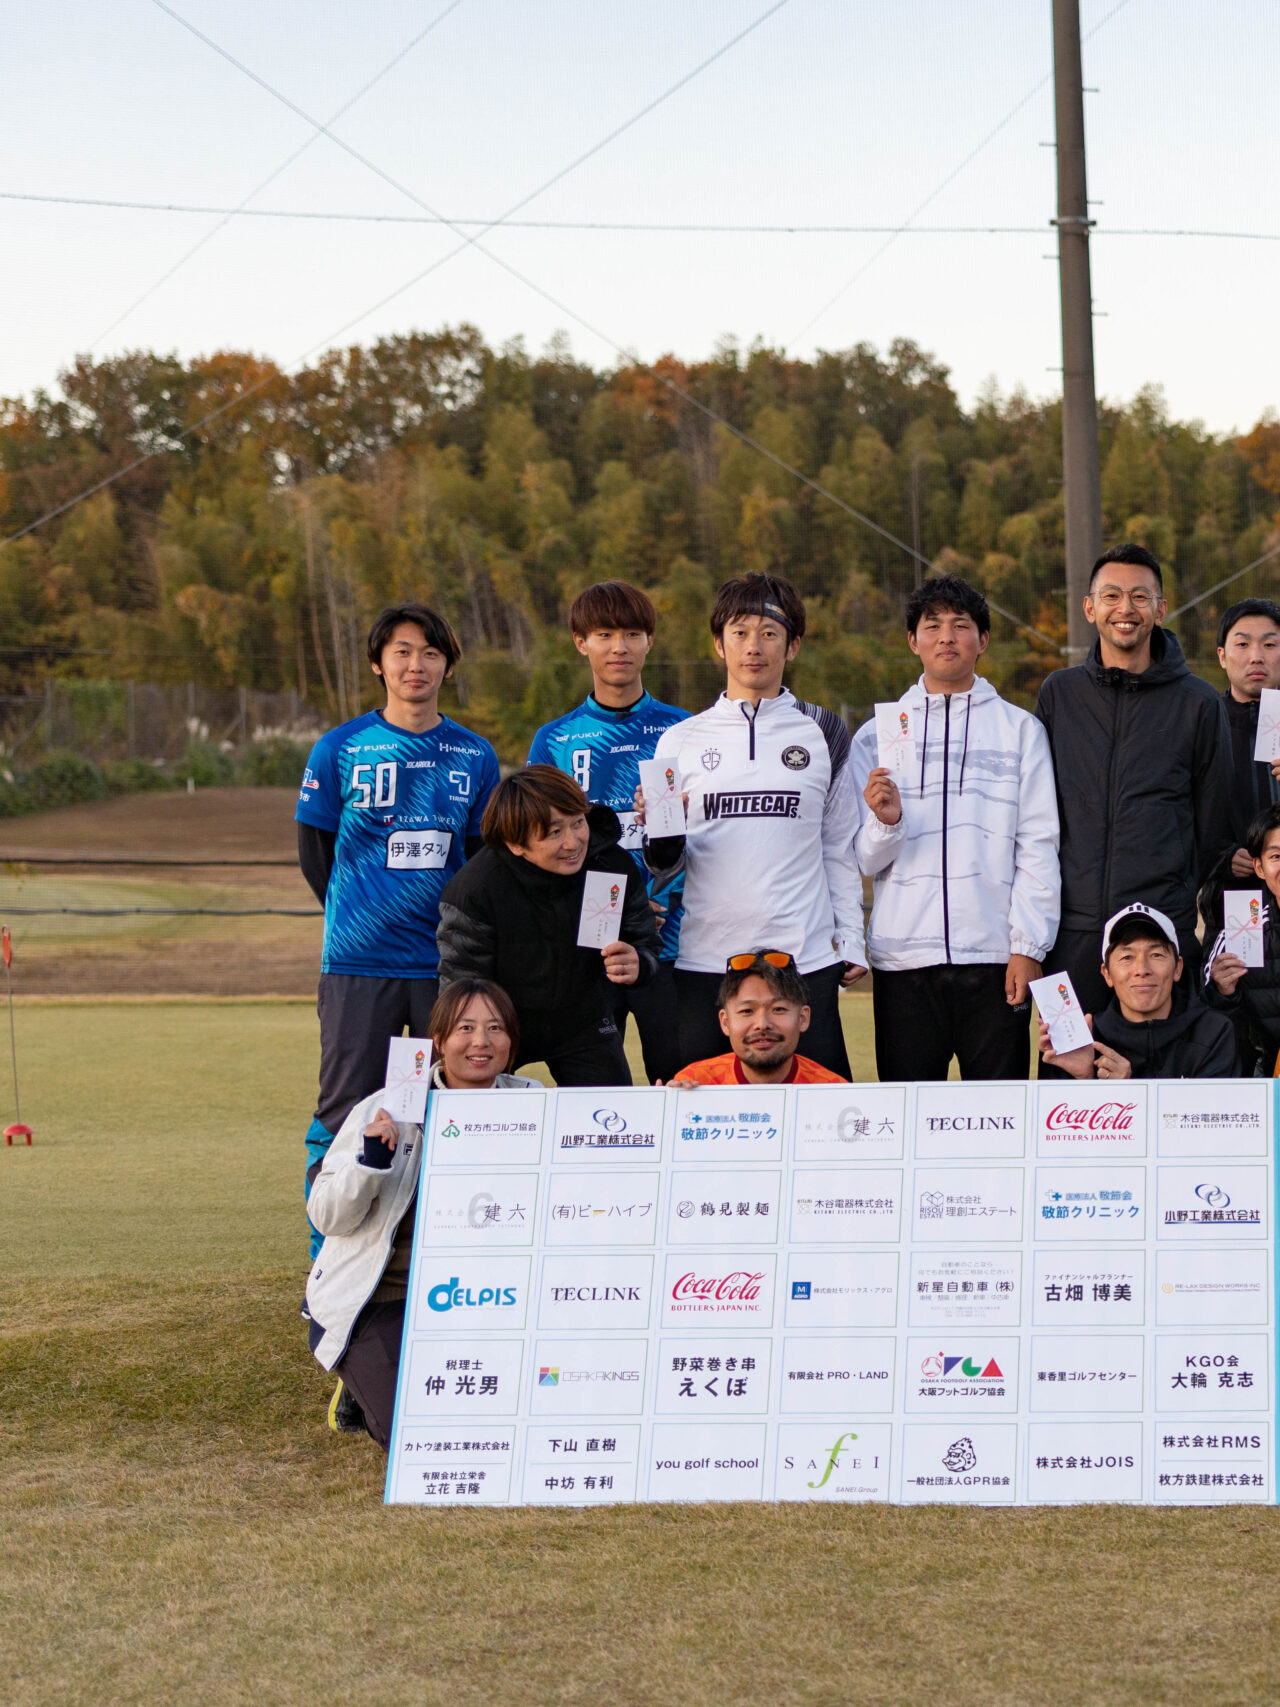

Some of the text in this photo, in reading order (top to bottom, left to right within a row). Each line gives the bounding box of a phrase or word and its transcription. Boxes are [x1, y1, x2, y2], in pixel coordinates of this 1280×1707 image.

[571, 748, 592, 793] 8
[352, 761, 398, 809] 50
[1046, 1103, 1136, 1130] Coca-Cola
[1181, 1113, 1259, 1122] 木谷電器株式会社
[464, 1123, 536, 1131] 枚方市ゴルフ協会
[853, 1117, 894, 1136] 建六
[927, 1117, 1014, 1130] TECLINK
[561, 1134, 655, 1145] 小野工業株式会社
[681, 1128, 777, 1140] 敬節クリニック
[815, 1199, 893, 1208] 木谷電器株式会社
[947, 1196, 981, 1204] 株式会社
[483, 1203, 526, 1223] 建六
[552, 1203, 652, 1220] (有)ビーハイブ
[701, 1202, 769, 1216] 鶴見製麺
[946, 1207, 1016, 1216] 理創エステート
[1042, 1206, 1139, 1219] 敬節クリニック
[1165, 1210, 1260, 1222] 小野工業株式会社
[672, 1272, 765, 1300] Coca-Cola
[551, 1288, 640, 1301] TECLINK
[1044, 1284, 1131, 1302] 古畑 博美
[446, 1360, 483, 1370] 税理士
[672, 1357, 755, 1371] 野菜巻き串
[1186, 1355, 1239, 1367] KGO会
[788, 1371, 824, 1380] 有限会社
[1038, 1372, 1136, 1381] 東香里ゴルフセンター
[1172, 1372, 1253, 1388] 大輪 克志
[425, 1375, 498, 1395] 仲 光男
[679, 1377, 748, 1397] えくぼ
[919, 1387, 1005, 1396] 大阪フットゴルフ協会
[405, 1442, 509, 1451] カトウ塗装工業株式会社
[549, 1438, 616, 1452] 下山 直樹
[1163, 1435, 1260, 1448] 株式会社RMS
[656, 1458, 758, 1470] you golf school
[1036, 1456, 1133, 1469] 株式会社JOIS
[545, 1476, 613, 1490] 中坊 有利
[907, 1476, 1010, 1485] 一般社団法人GPR協会
[1159, 1474, 1264, 1486] 枚方鉄建株式会社
[425, 1483, 480, 1494] 立花 吉隆
